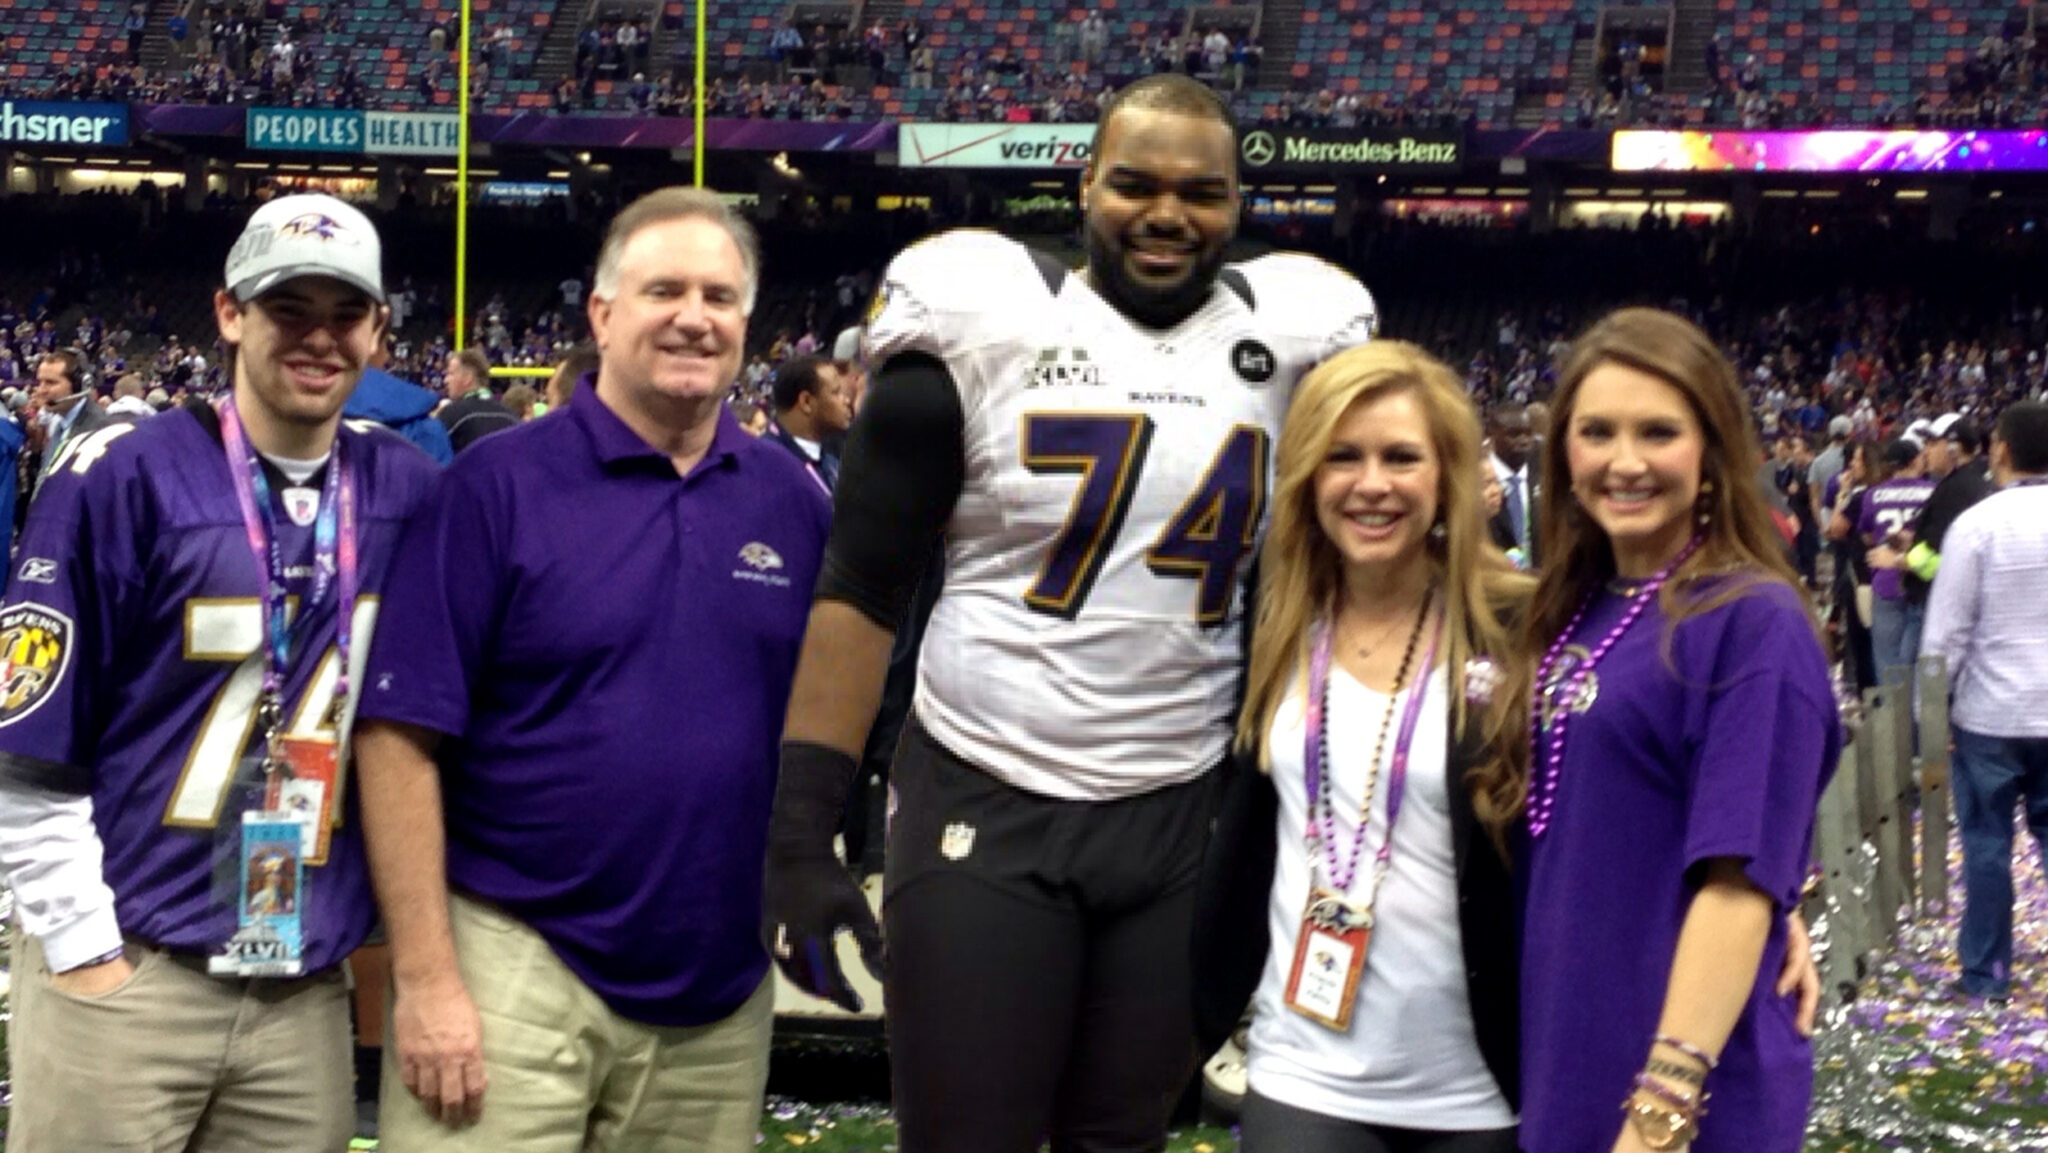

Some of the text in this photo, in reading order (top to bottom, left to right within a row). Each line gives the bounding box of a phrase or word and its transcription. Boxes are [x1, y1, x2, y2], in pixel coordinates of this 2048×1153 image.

[0, 101, 110, 143] hsner
[254, 114, 459, 147] PEOPLES HEALTH
[1001, 136, 1089, 165] verizo
[1283, 136, 1456, 163] Mercedes-Benz
[1019, 409, 1270, 628] 74
[162, 594, 381, 828] 74
